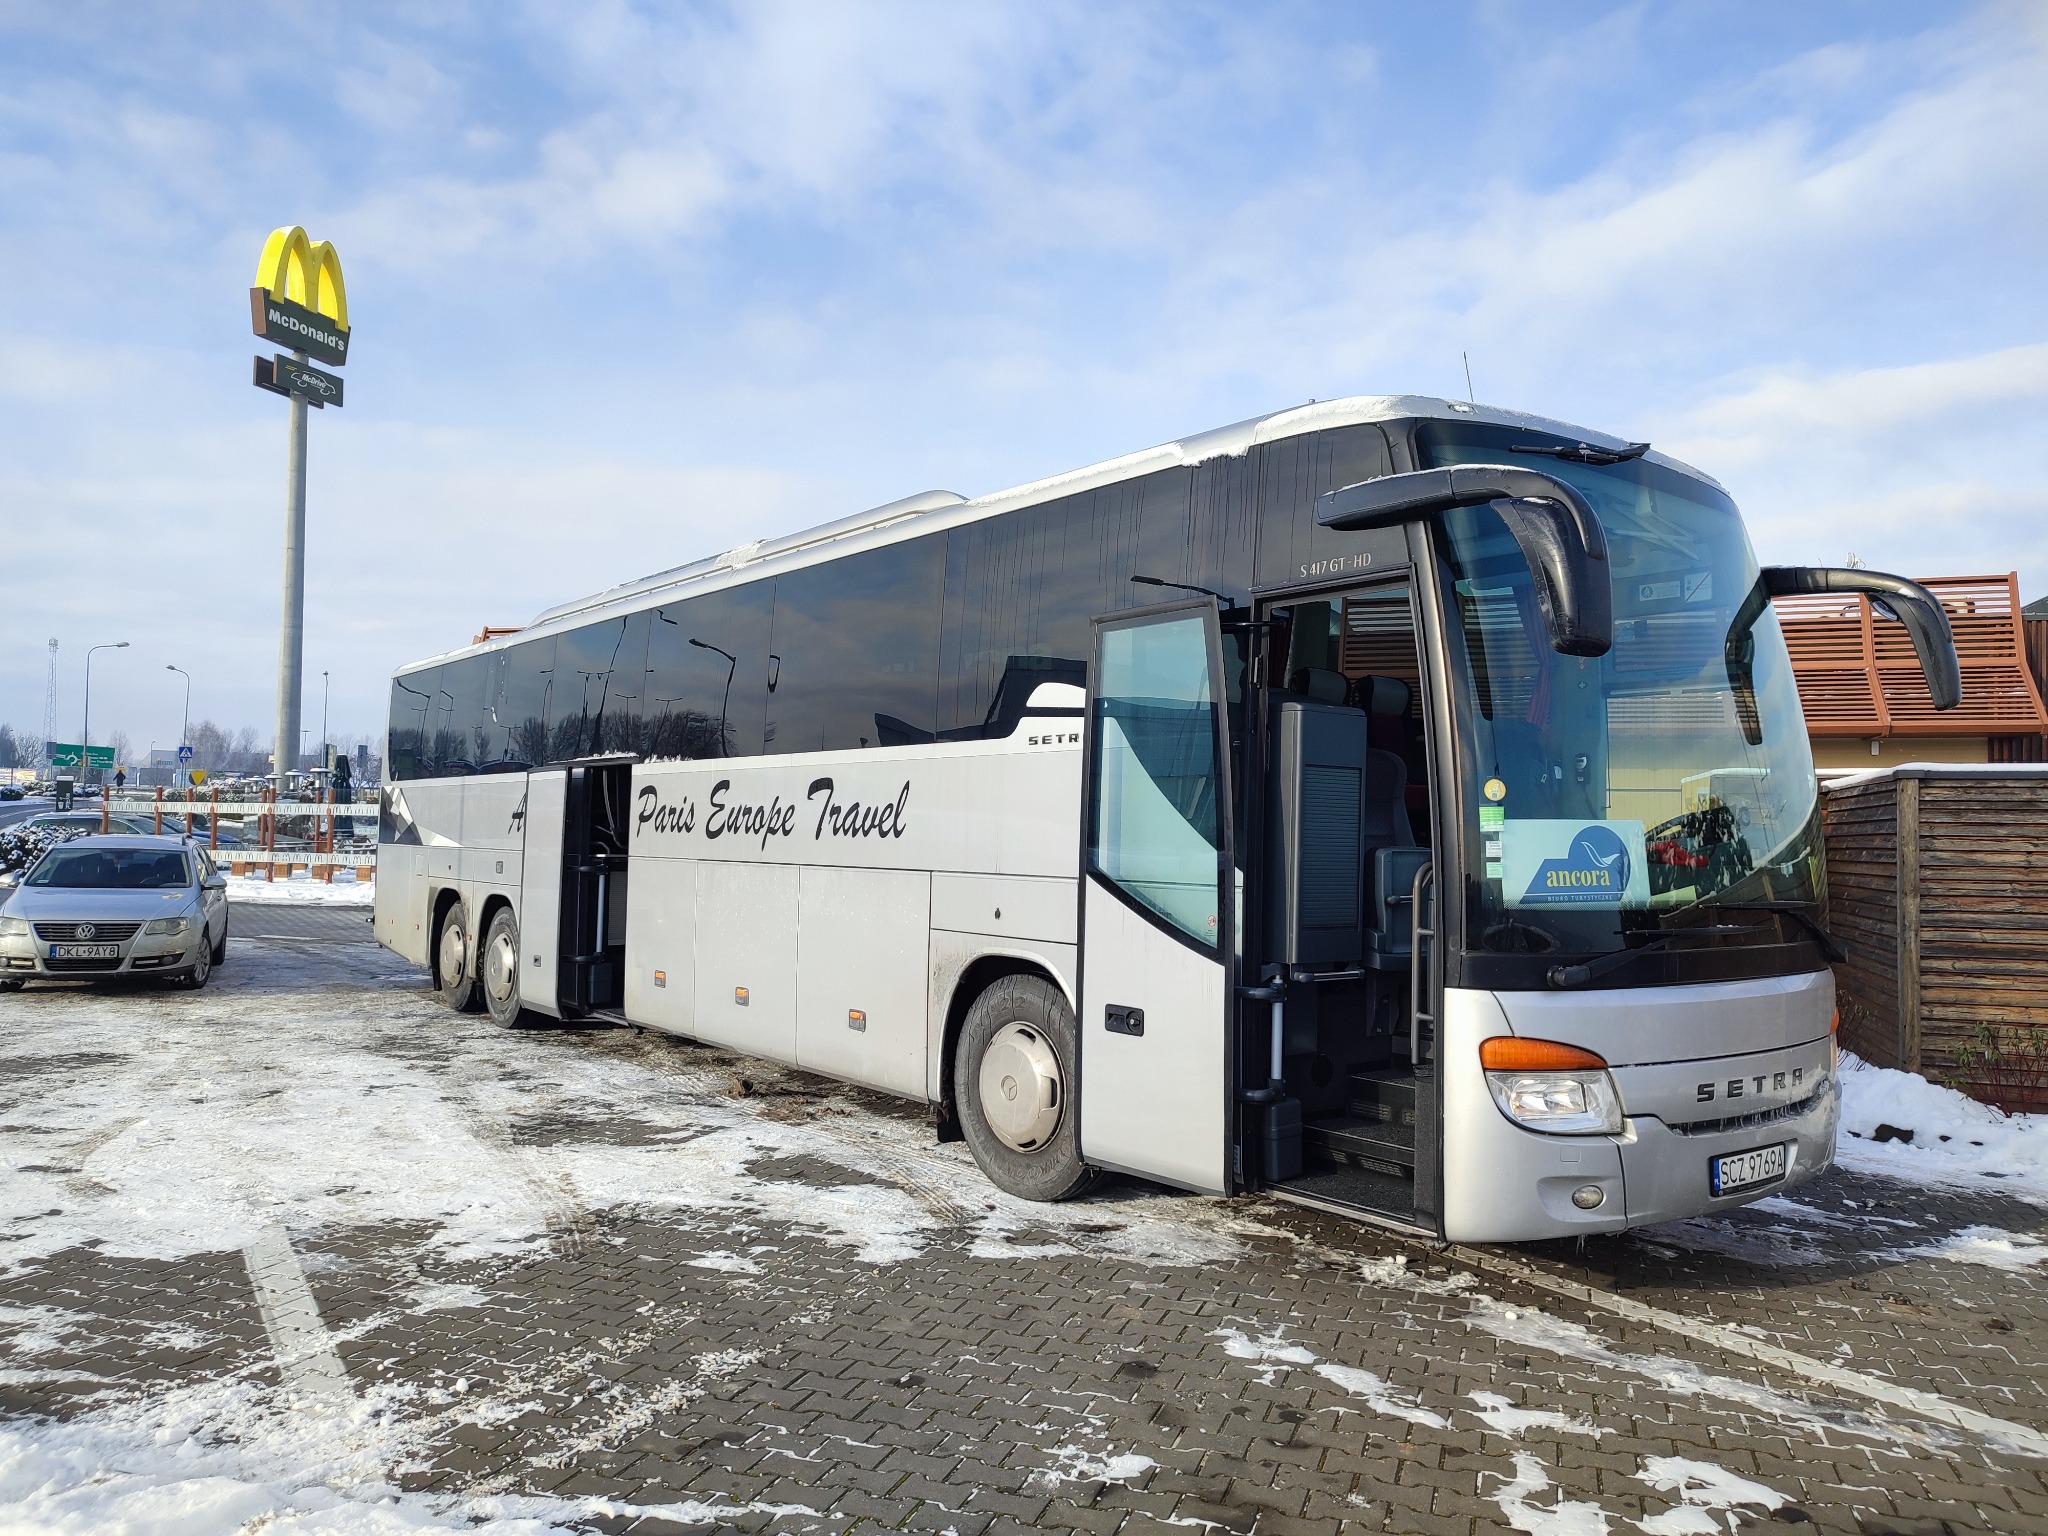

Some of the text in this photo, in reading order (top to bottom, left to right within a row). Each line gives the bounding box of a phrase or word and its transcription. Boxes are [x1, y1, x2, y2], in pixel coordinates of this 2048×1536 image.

[268, 308, 345, 351] McDonald's
[301, 373, 327, 389] McDrive
[1300, 564, 1307, 578] S
[1309, 560, 1327, 576] 417
[1028, 733, 1080, 746] SETR
[636, 777, 910, 852] Paris Europe Travel
[1546, 869, 1611, 888] ancora
[58, 946, 116, 957] DKL 9AY8
[1696, 1067, 1803, 1103] SETRA
[1720, 1157, 1746, 1186] SCZ
[1749, 1147, 1784, 1180] 9769A
